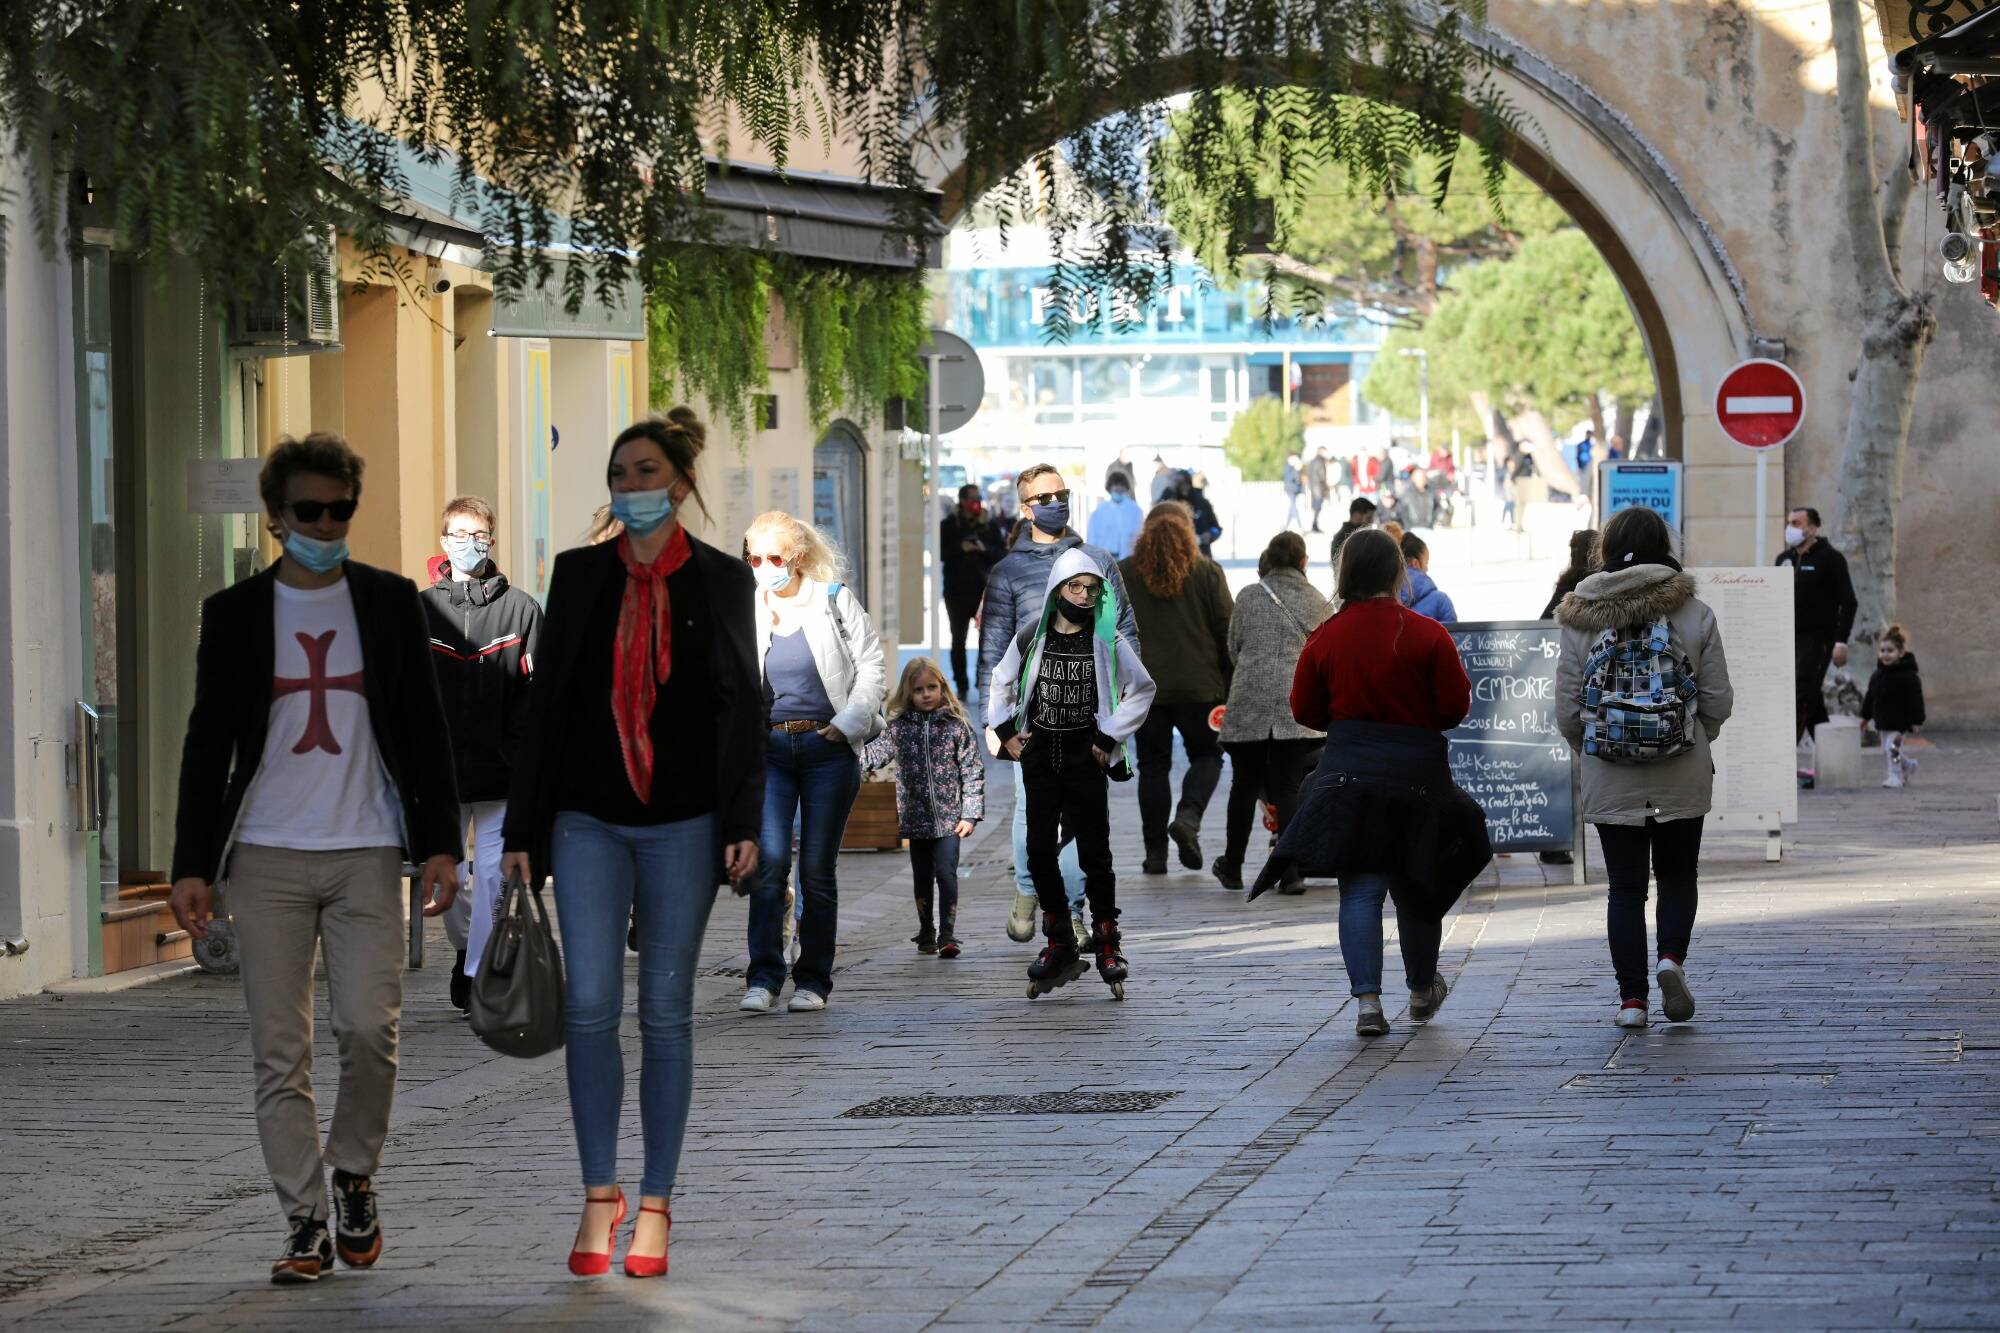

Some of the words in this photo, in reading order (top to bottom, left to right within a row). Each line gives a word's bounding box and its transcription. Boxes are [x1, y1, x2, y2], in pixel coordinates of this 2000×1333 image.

[1030, 285, 1192, 325] PORT
[1651, 497, 1671, 508] DU
[1040, 659, 1093, 681] MAKE
[1040, 681, 1092, 704] SOME
